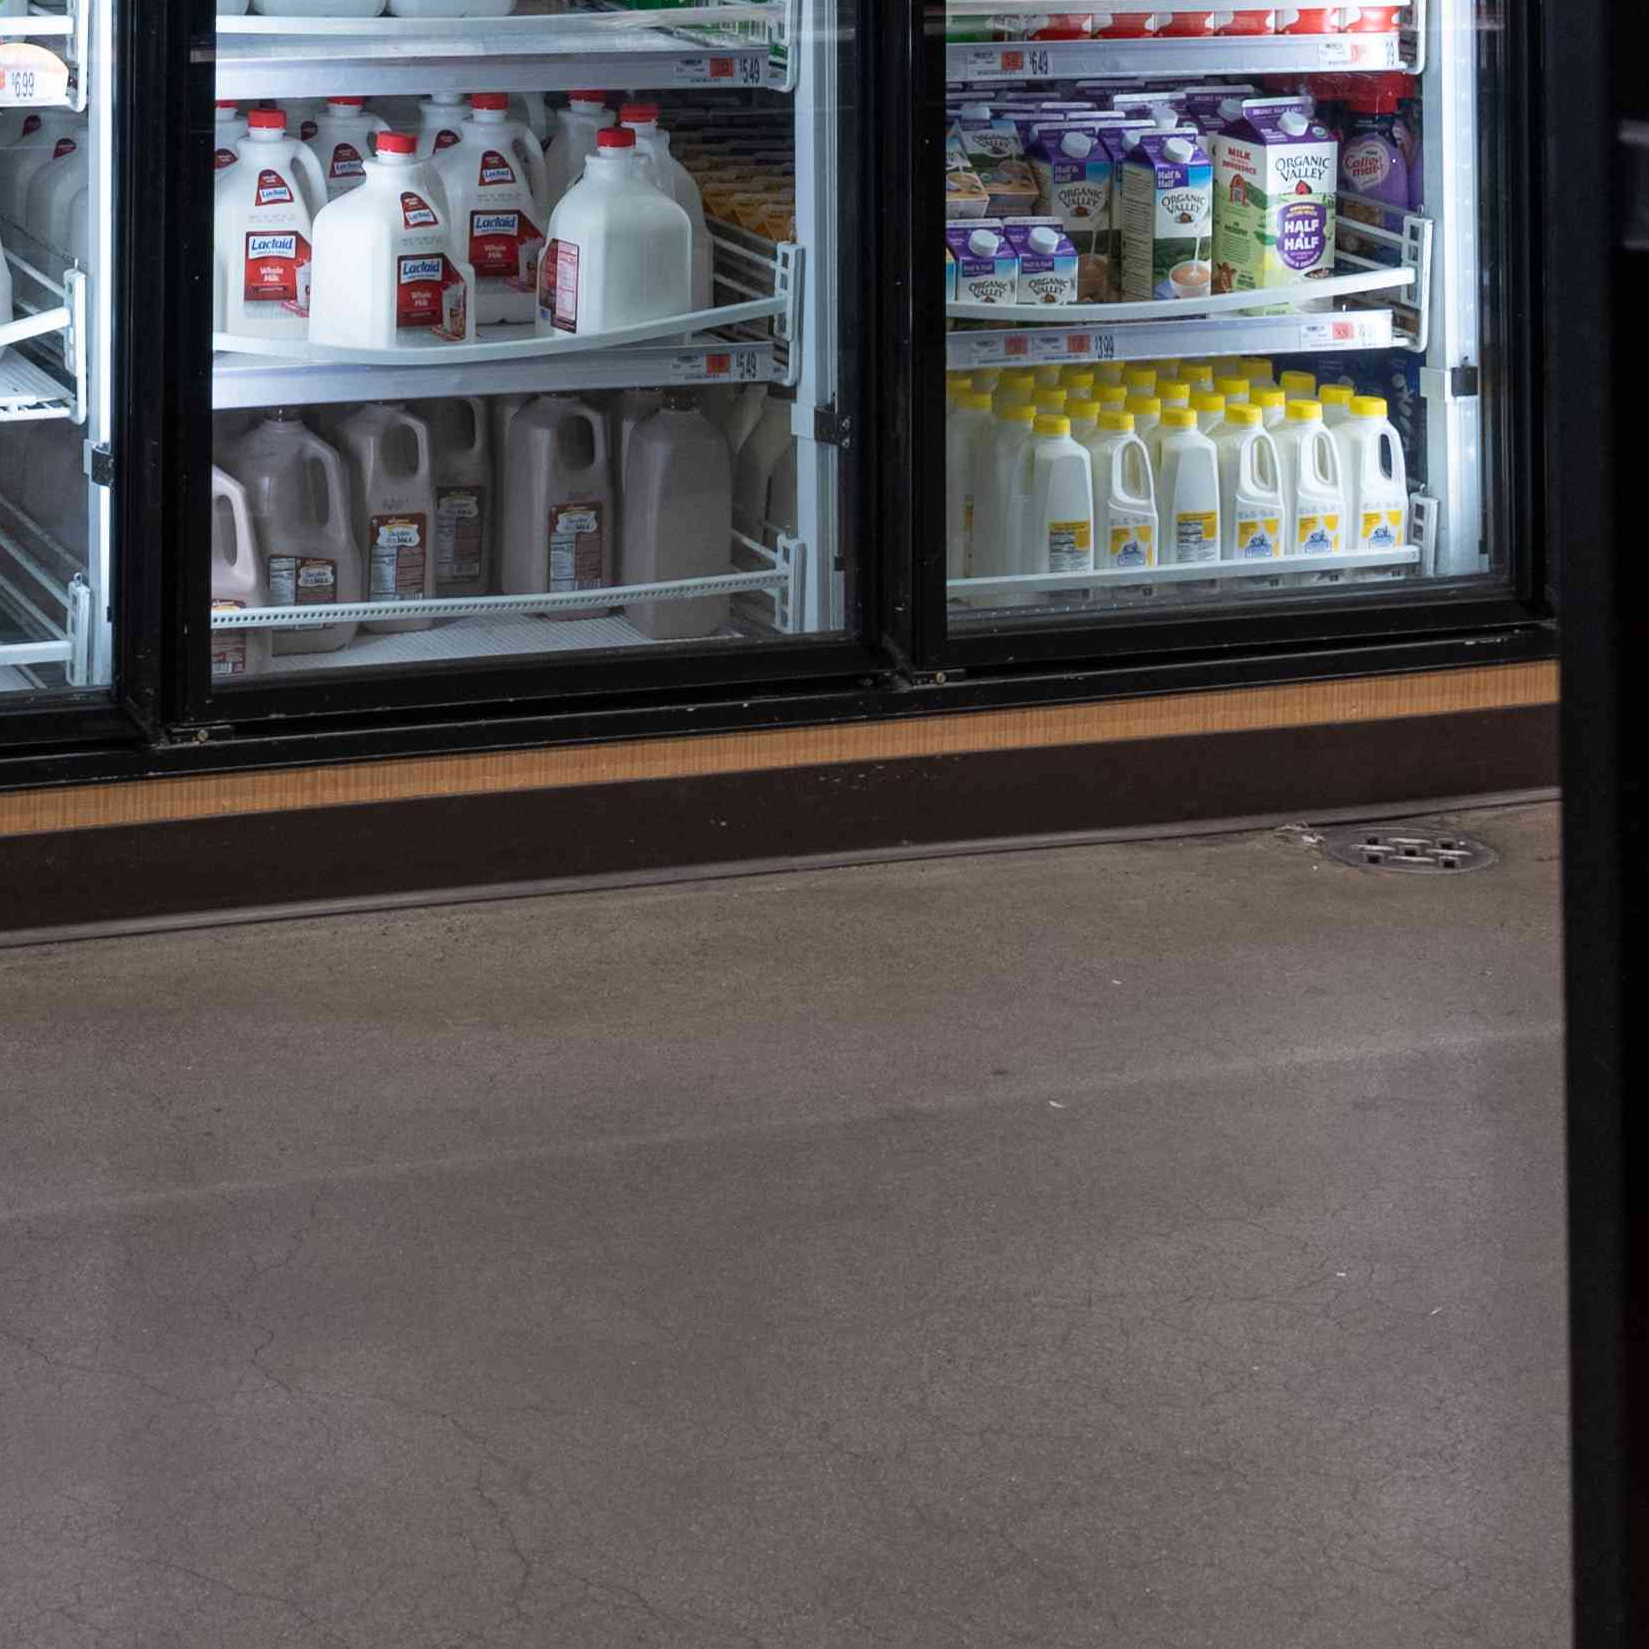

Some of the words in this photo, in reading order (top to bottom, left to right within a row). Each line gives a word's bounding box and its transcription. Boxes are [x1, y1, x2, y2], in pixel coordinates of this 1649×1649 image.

[1275, 156, 1330, 171] ORGANIC
[1157, 170, 1174, 180] Half
[1279, 168, 1326, 182] VALLEY
[1158, 180, 1175, 188] Half
[262, 188, 287, 199] Lactaid
[1161, 195, 1205, 206] ORGANIC
[1166, 202, 1202, 214] VALLEY
[476, 215, 516, 229] Lactaid
[1284, 220, 1319, 233] HALF
[251, 237, 294, 251] Lactaid
[1284, 237, 1319, 251] HALF
[403, 260, 440, 274] Lactaid
[1028, 278, 1068, 290] ORGANIC
[1035, 284, 1063, 296] VALLEY
